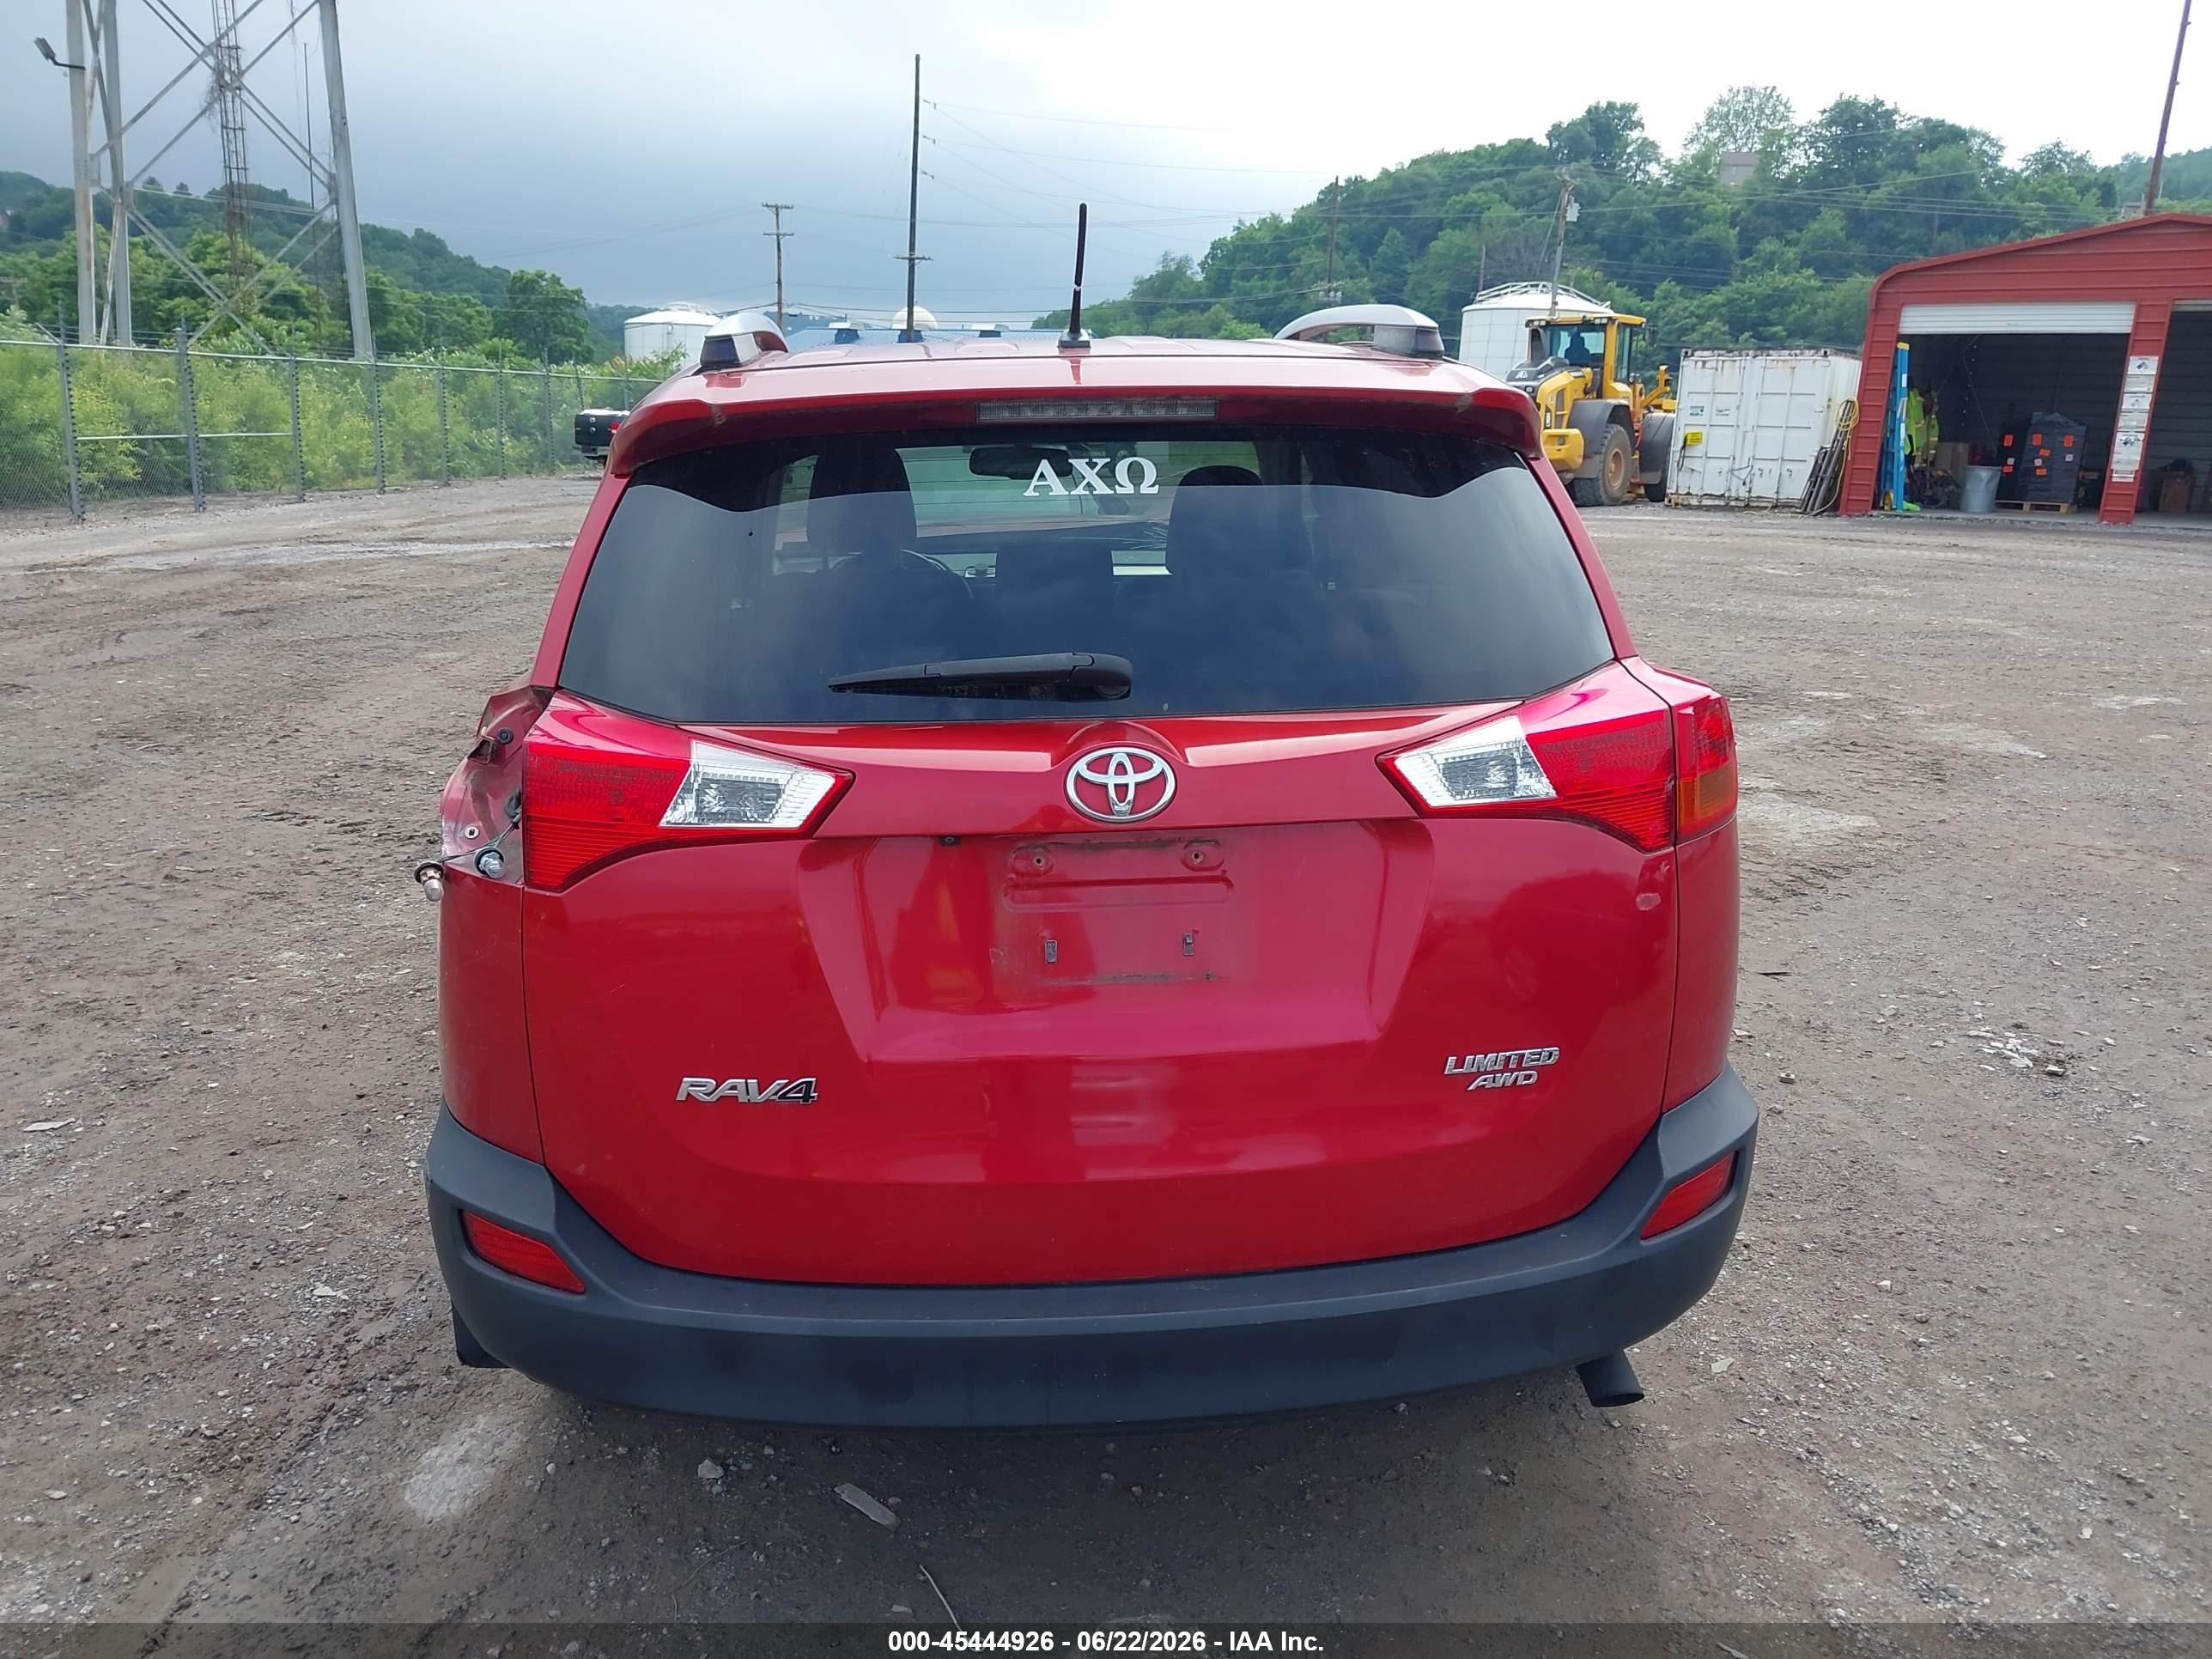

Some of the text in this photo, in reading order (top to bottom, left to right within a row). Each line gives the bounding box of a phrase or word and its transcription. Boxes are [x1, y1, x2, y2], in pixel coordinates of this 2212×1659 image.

[1443, 1047, 1560, 1074] LIMITED
[676, 1077, 818, 1104] RAV4
[1467, 1071, 1538, 1091] AWD
